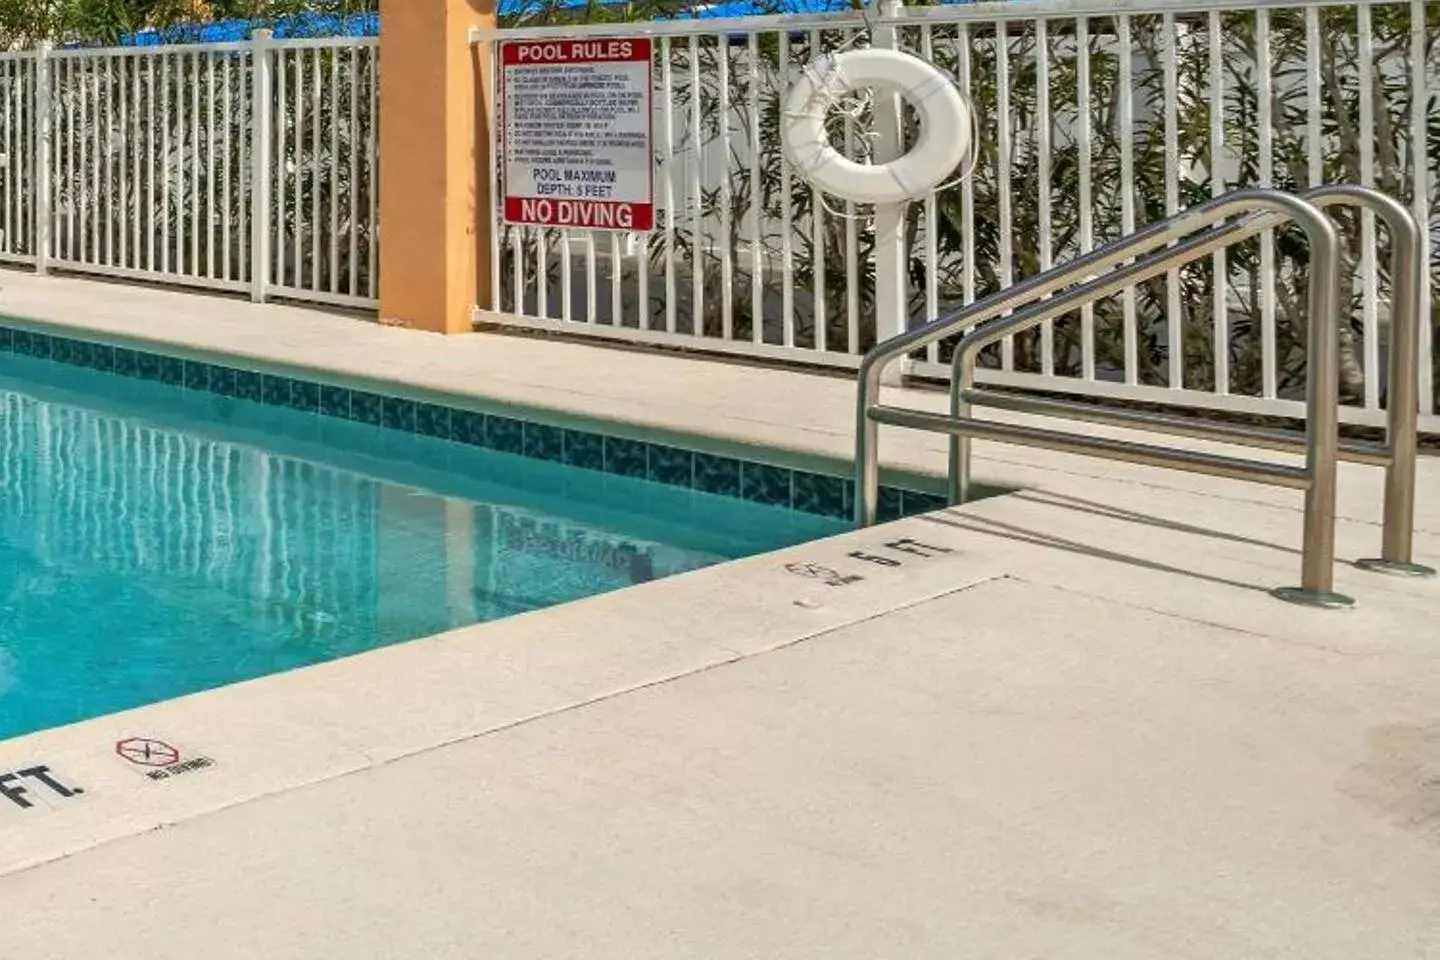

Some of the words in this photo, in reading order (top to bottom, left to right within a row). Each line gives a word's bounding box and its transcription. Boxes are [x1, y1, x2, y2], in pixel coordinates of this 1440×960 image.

[518, 45, 567, 61] POOL
[571, 42, 633, 59] RULES
[533, 168, 561, 181] POOL
[564, 170, 616, 183] MAXIMUM
[537, 184, 573, 196] DEPTH:
[585, 186, 613, 197] FEET
[521, 199, 552, 222] NO
[558, 201, 633, 227] DIVING
